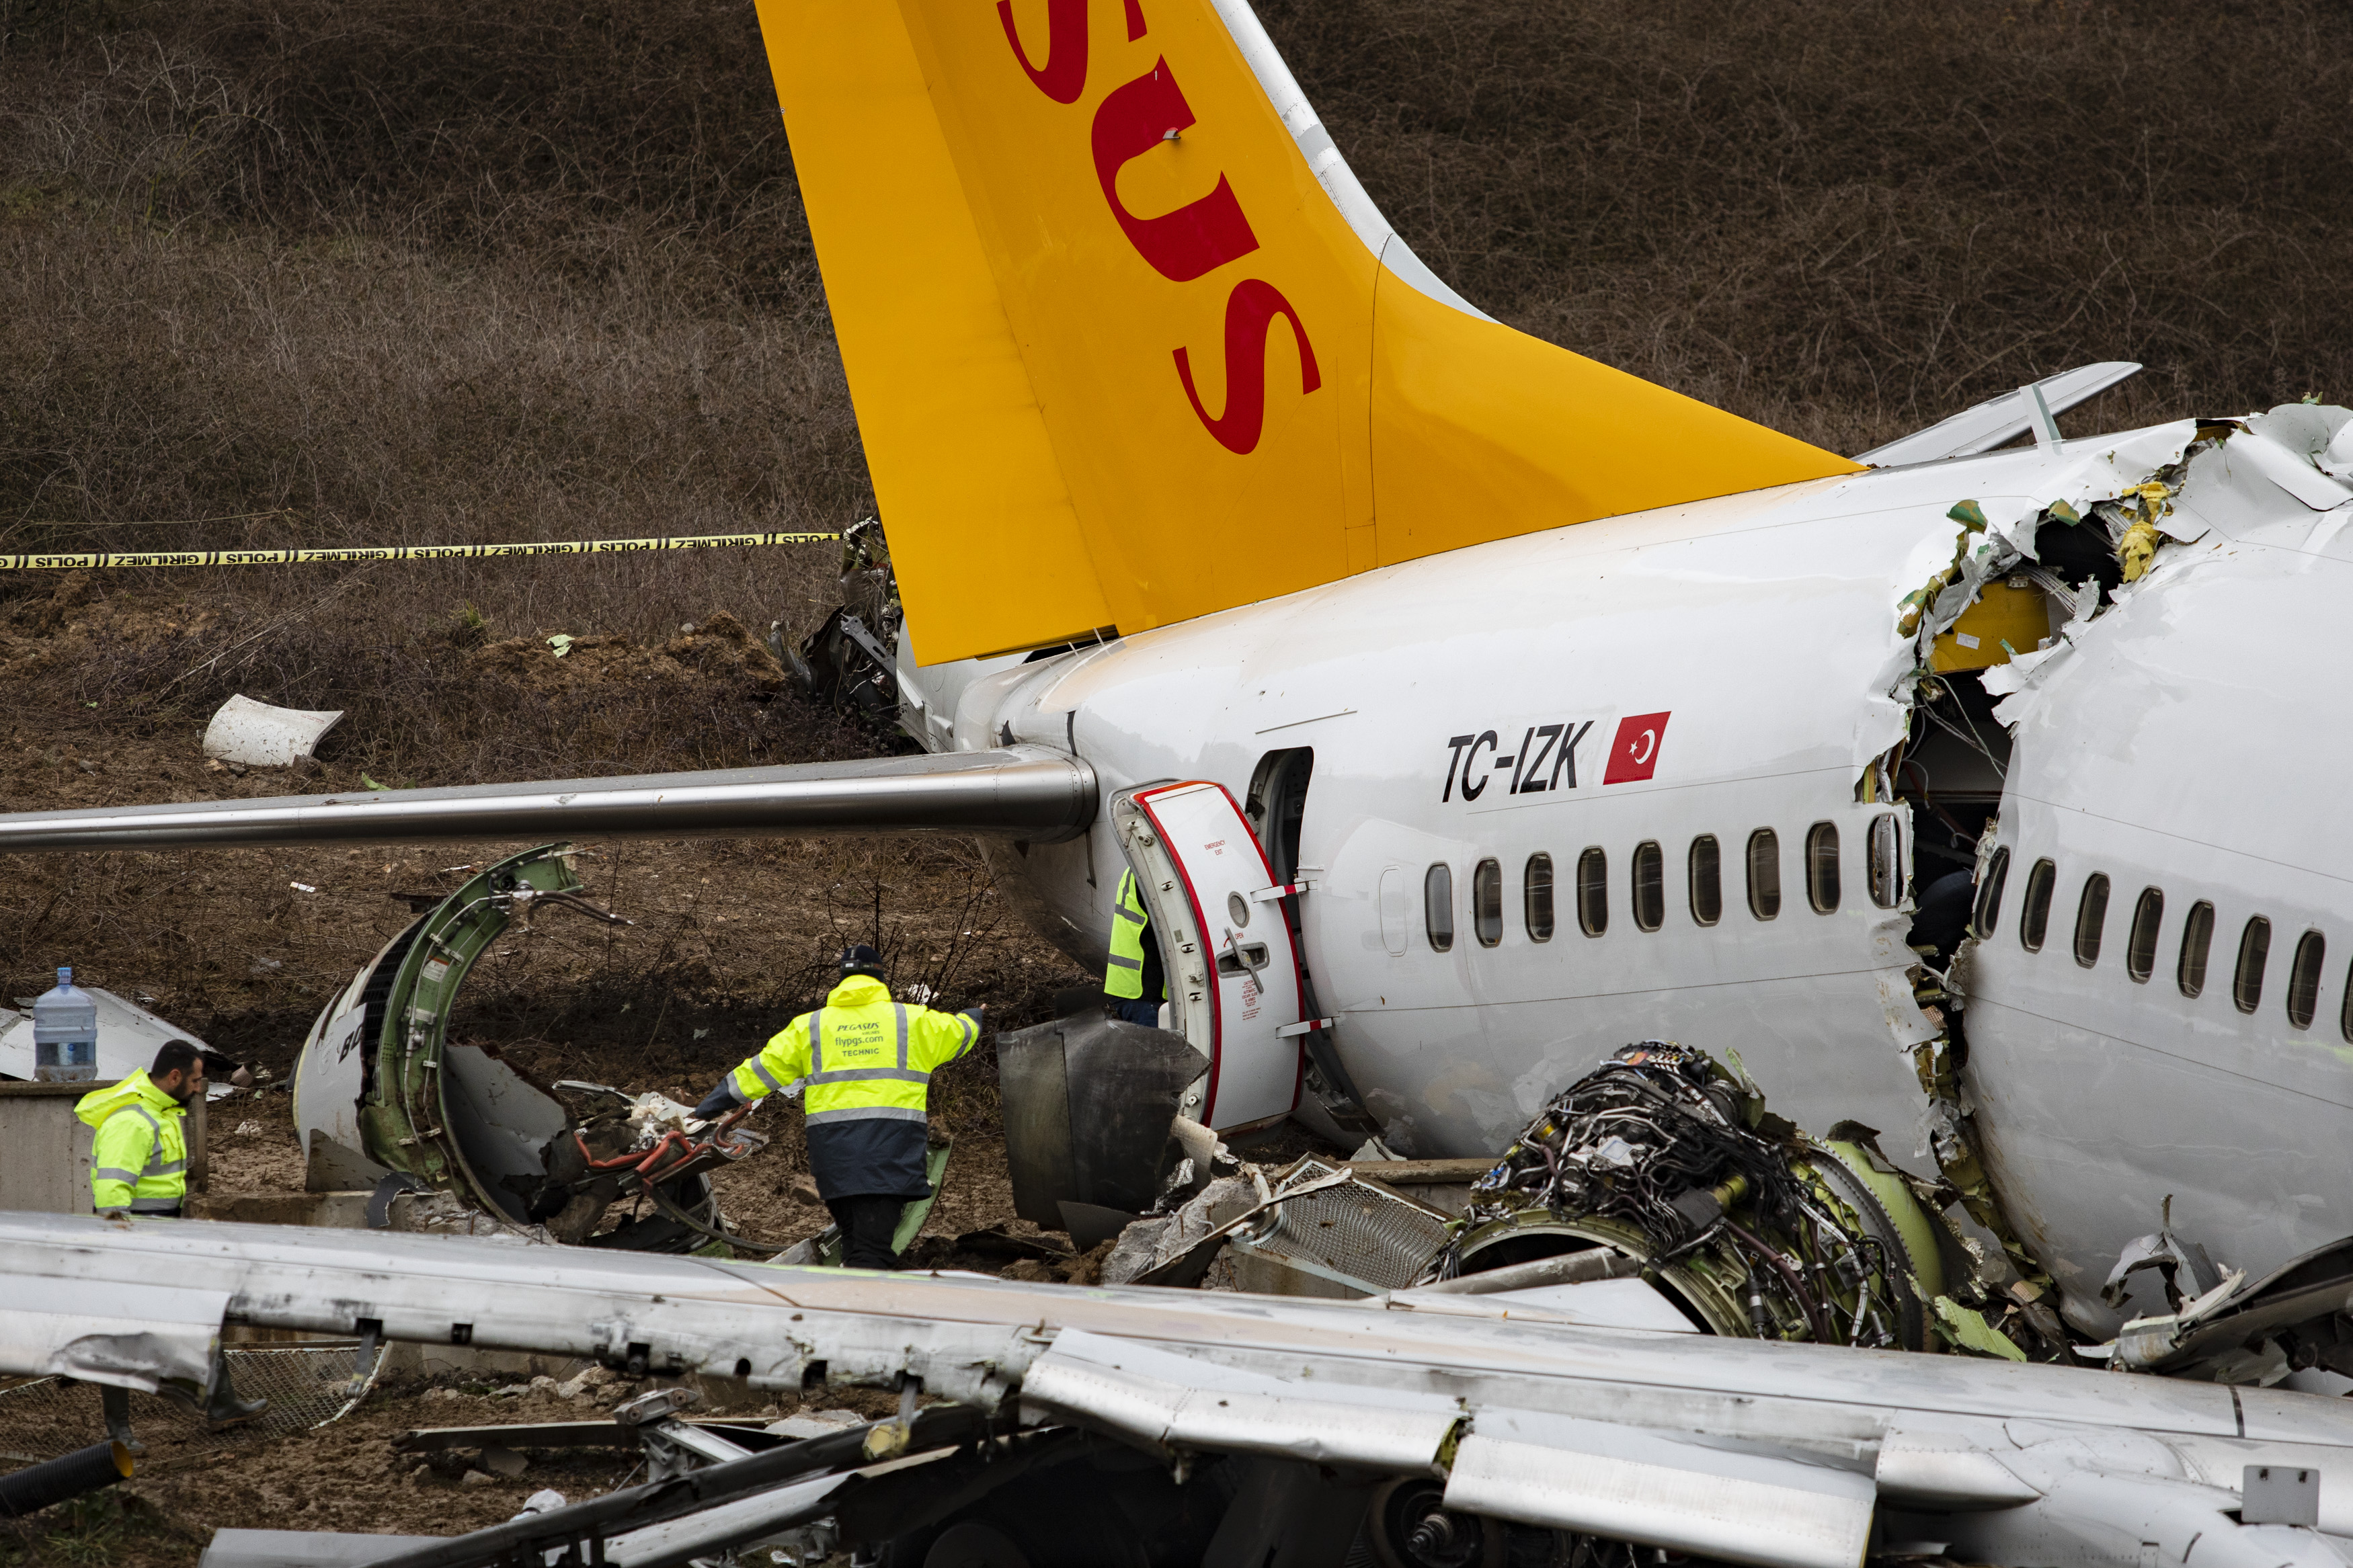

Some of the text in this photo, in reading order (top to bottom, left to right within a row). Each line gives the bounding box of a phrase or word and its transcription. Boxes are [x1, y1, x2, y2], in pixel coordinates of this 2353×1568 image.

[1442, 720, 1595, 802] TC-IZK
[1204, 839, 1226, 850] EMERGENCY
[836, 1022, 880, 1032] PEGASUS
[835, 1036, 883, 1047] flypgs.com
[842, 1048, 879, 1057] TECHNIC
